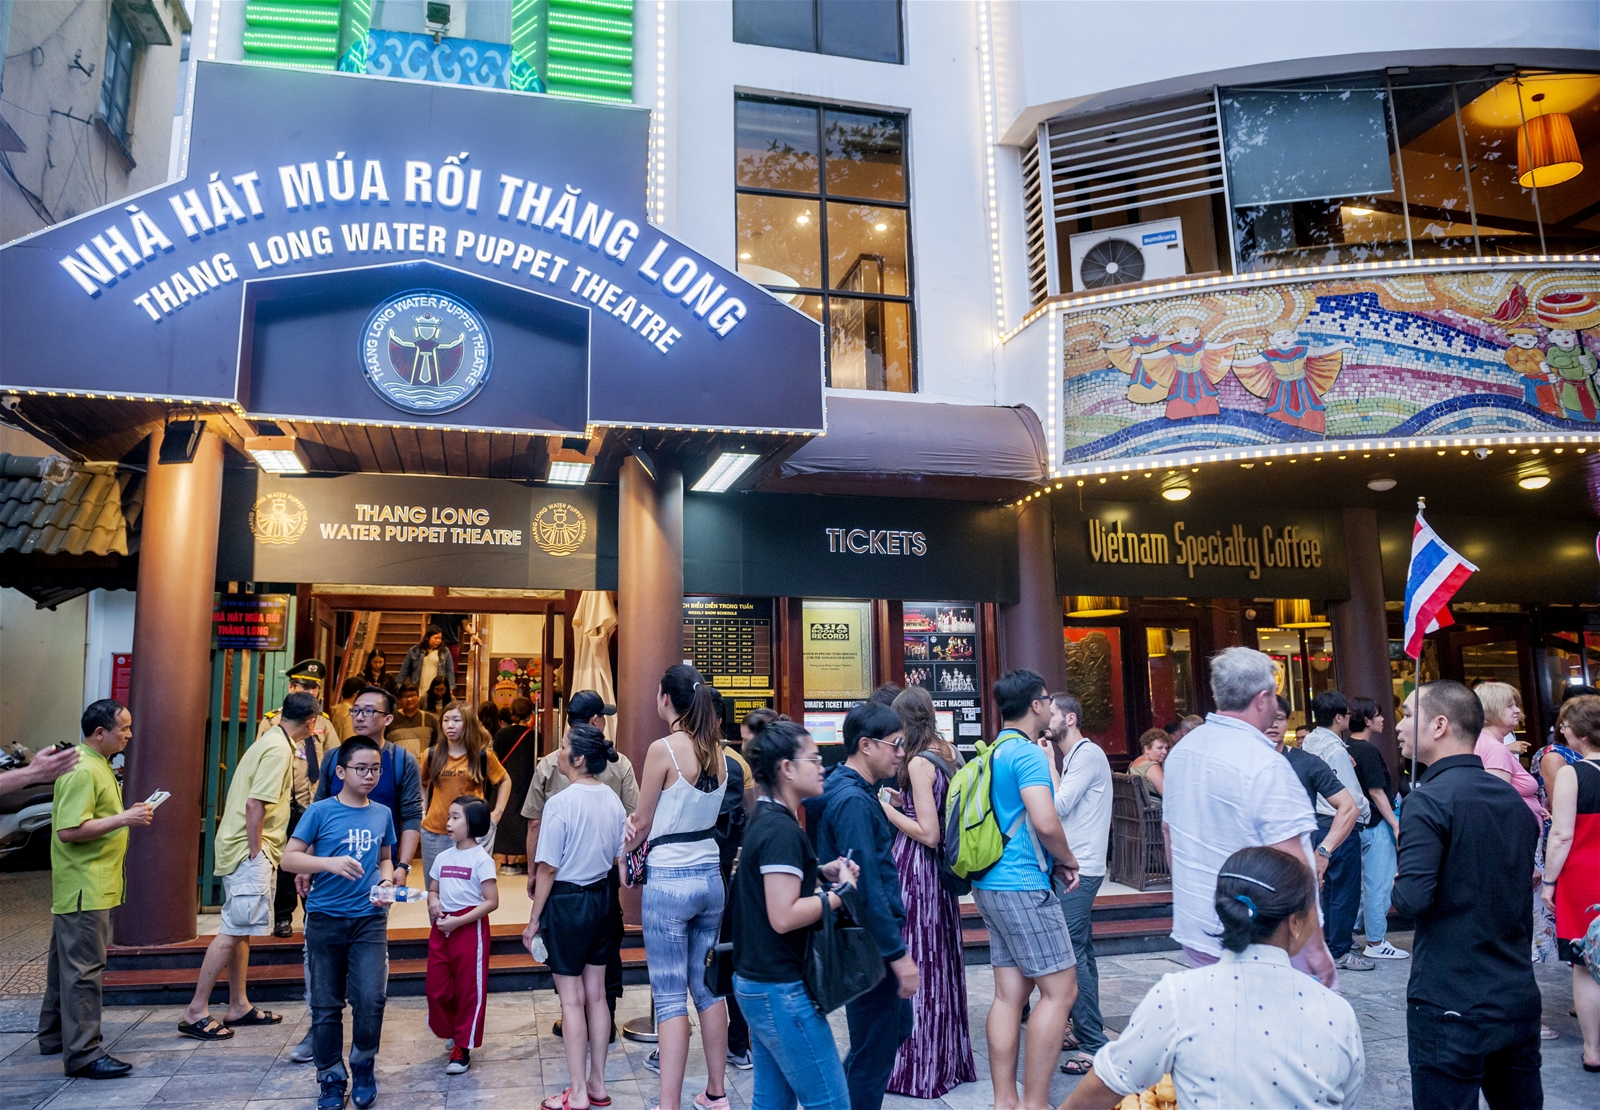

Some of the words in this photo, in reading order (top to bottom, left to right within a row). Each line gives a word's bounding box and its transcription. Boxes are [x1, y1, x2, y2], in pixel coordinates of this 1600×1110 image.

[59, 204, 173, 297] NHÀ
[168, 171, 264, 239] HÁT
[277, 152, 391, 209] MÚA
[404, 151, 483, 213] RỐI
[497, 183, 640, 264] THĂNG
[638, 238, 748, 340] LONG
[1143, 232, 1176, 245] sumikura
[133, 252, 239, 323] THANG
[248, 226, 333, 271] LONG
[341, 221, 447, 254] WATER
[455, 229, 570, 284] PUPPET
[571, 266, 683, 355] THEATRE
[393, 297, 437, 312] WATER
[438, 299, 479, 333] PUPPET
[369, 308, 396, 338] LONG
[366, 339, 384, 381] THANG
[465, 332, 485, 386] THEATRE
[355, 503, 427, 523] THANG
[431, 506, 490, 526] LONG
[534, 506, 548, 521] LONG
[567, 504, 584, 520] PUPPET
[319, 523, 381, 541] WATER
[385, 525, 448, 543] PUPPET
[450, 527, 522, 546] THEATRE
[826, 527, 928, 556] TICKETS
[1089, 518, 1169, 564] Vietnam
[1174, 521, 1261, 579] Specialty
[1262, 525, 1322, 568] Coffee
[217, 624, 245, 635] THĂNG
[246, 625, 269, 636] LONG
[227, 611, 244, 622] HÁT
[245, 611, 264, 623] MÚA
[752, 701, 766, 709] OFFICE
